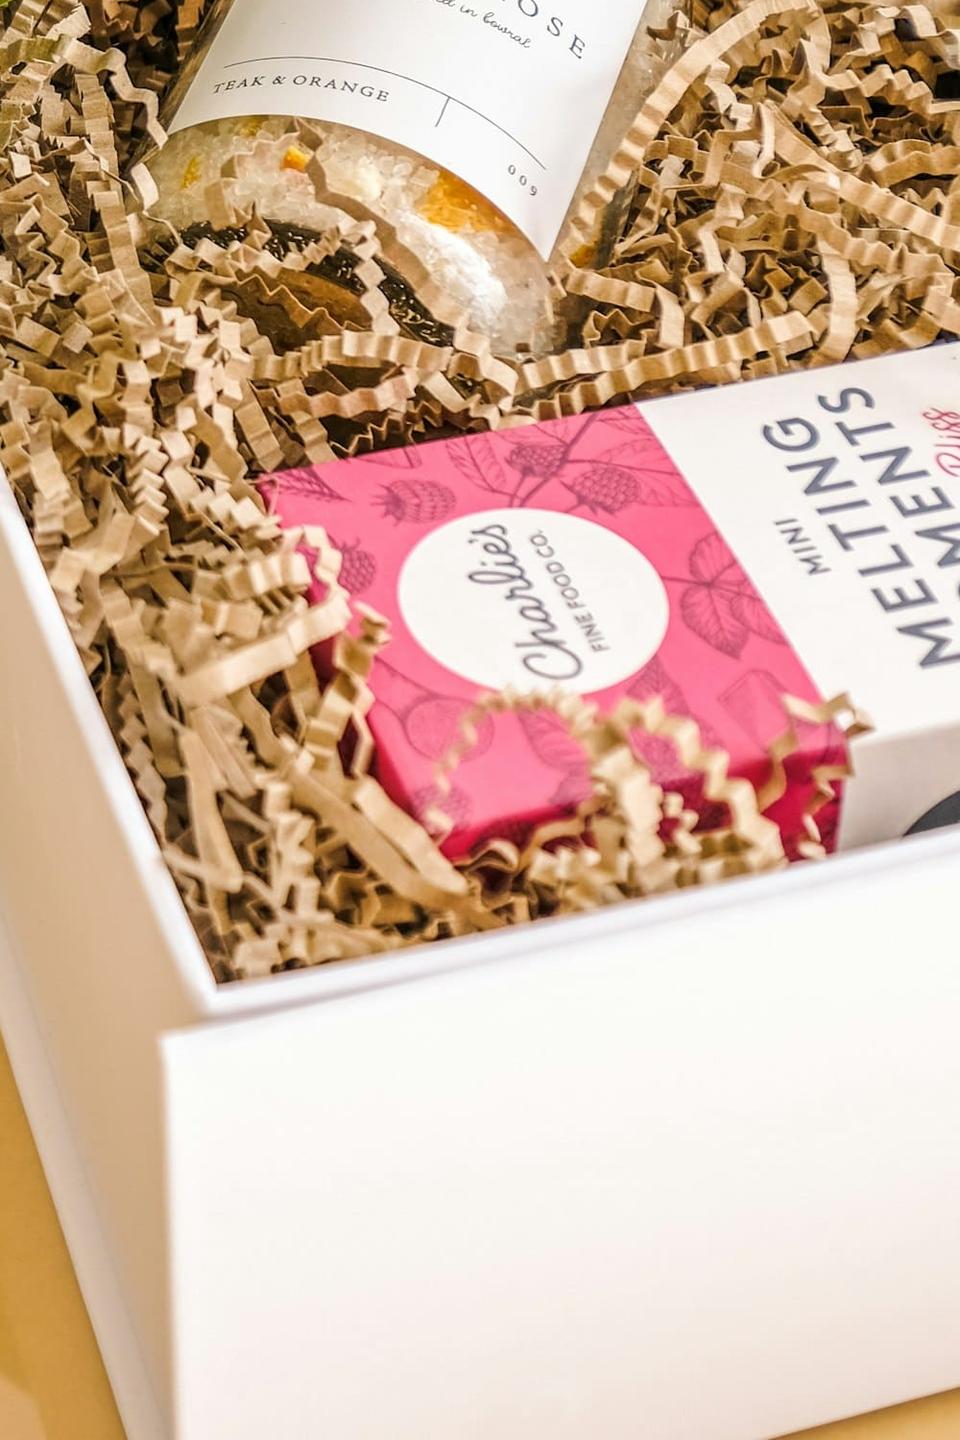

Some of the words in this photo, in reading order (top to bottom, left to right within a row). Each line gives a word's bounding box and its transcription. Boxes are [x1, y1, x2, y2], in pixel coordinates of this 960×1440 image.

[460, 4, 478, 17] in
[213, 75, 266, 94] TEAK
[272, 75, 286, 86] &
[292, 75, 390, 103] ORANGE
[507, 164, 538, 197] 009
[817, 387, 960, 602] MENTS
[530, 529, 555, 558] CO.
[762, 416, 960, 670] MELTING
[773, 517, 832, 576] MINI
[468, 524, 583, 680] Charlie's
[546, 561, 587, 609] FOOD
[574, 611, 610, 652] FINE
